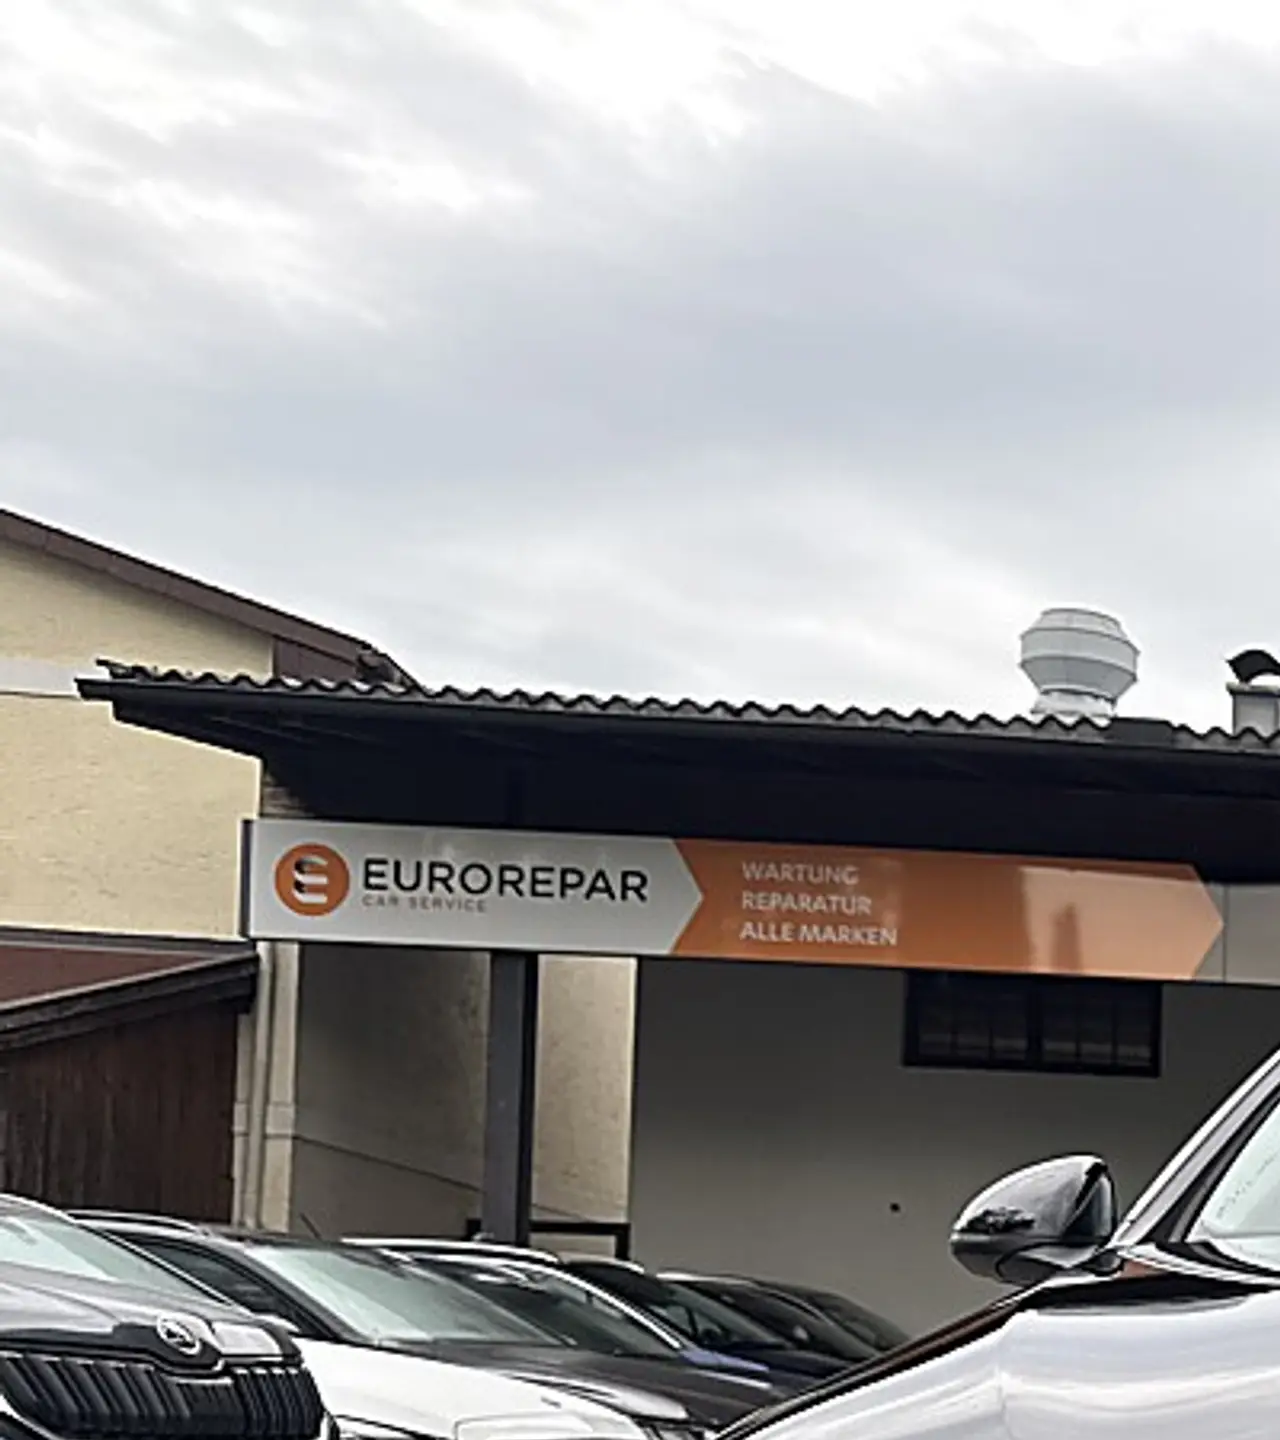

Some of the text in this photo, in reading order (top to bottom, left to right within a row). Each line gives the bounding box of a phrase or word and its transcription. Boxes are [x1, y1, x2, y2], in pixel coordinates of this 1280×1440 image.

[362, 858, 649, 902] EUROREPAR
[741, 861, 860, 885] WARTUNG
[362, 895, 488, 913] CAR SERVICE
[742, 891, 872, 915] REPARATUR
[739, 921, 898, 946] ALLE MARKEN
